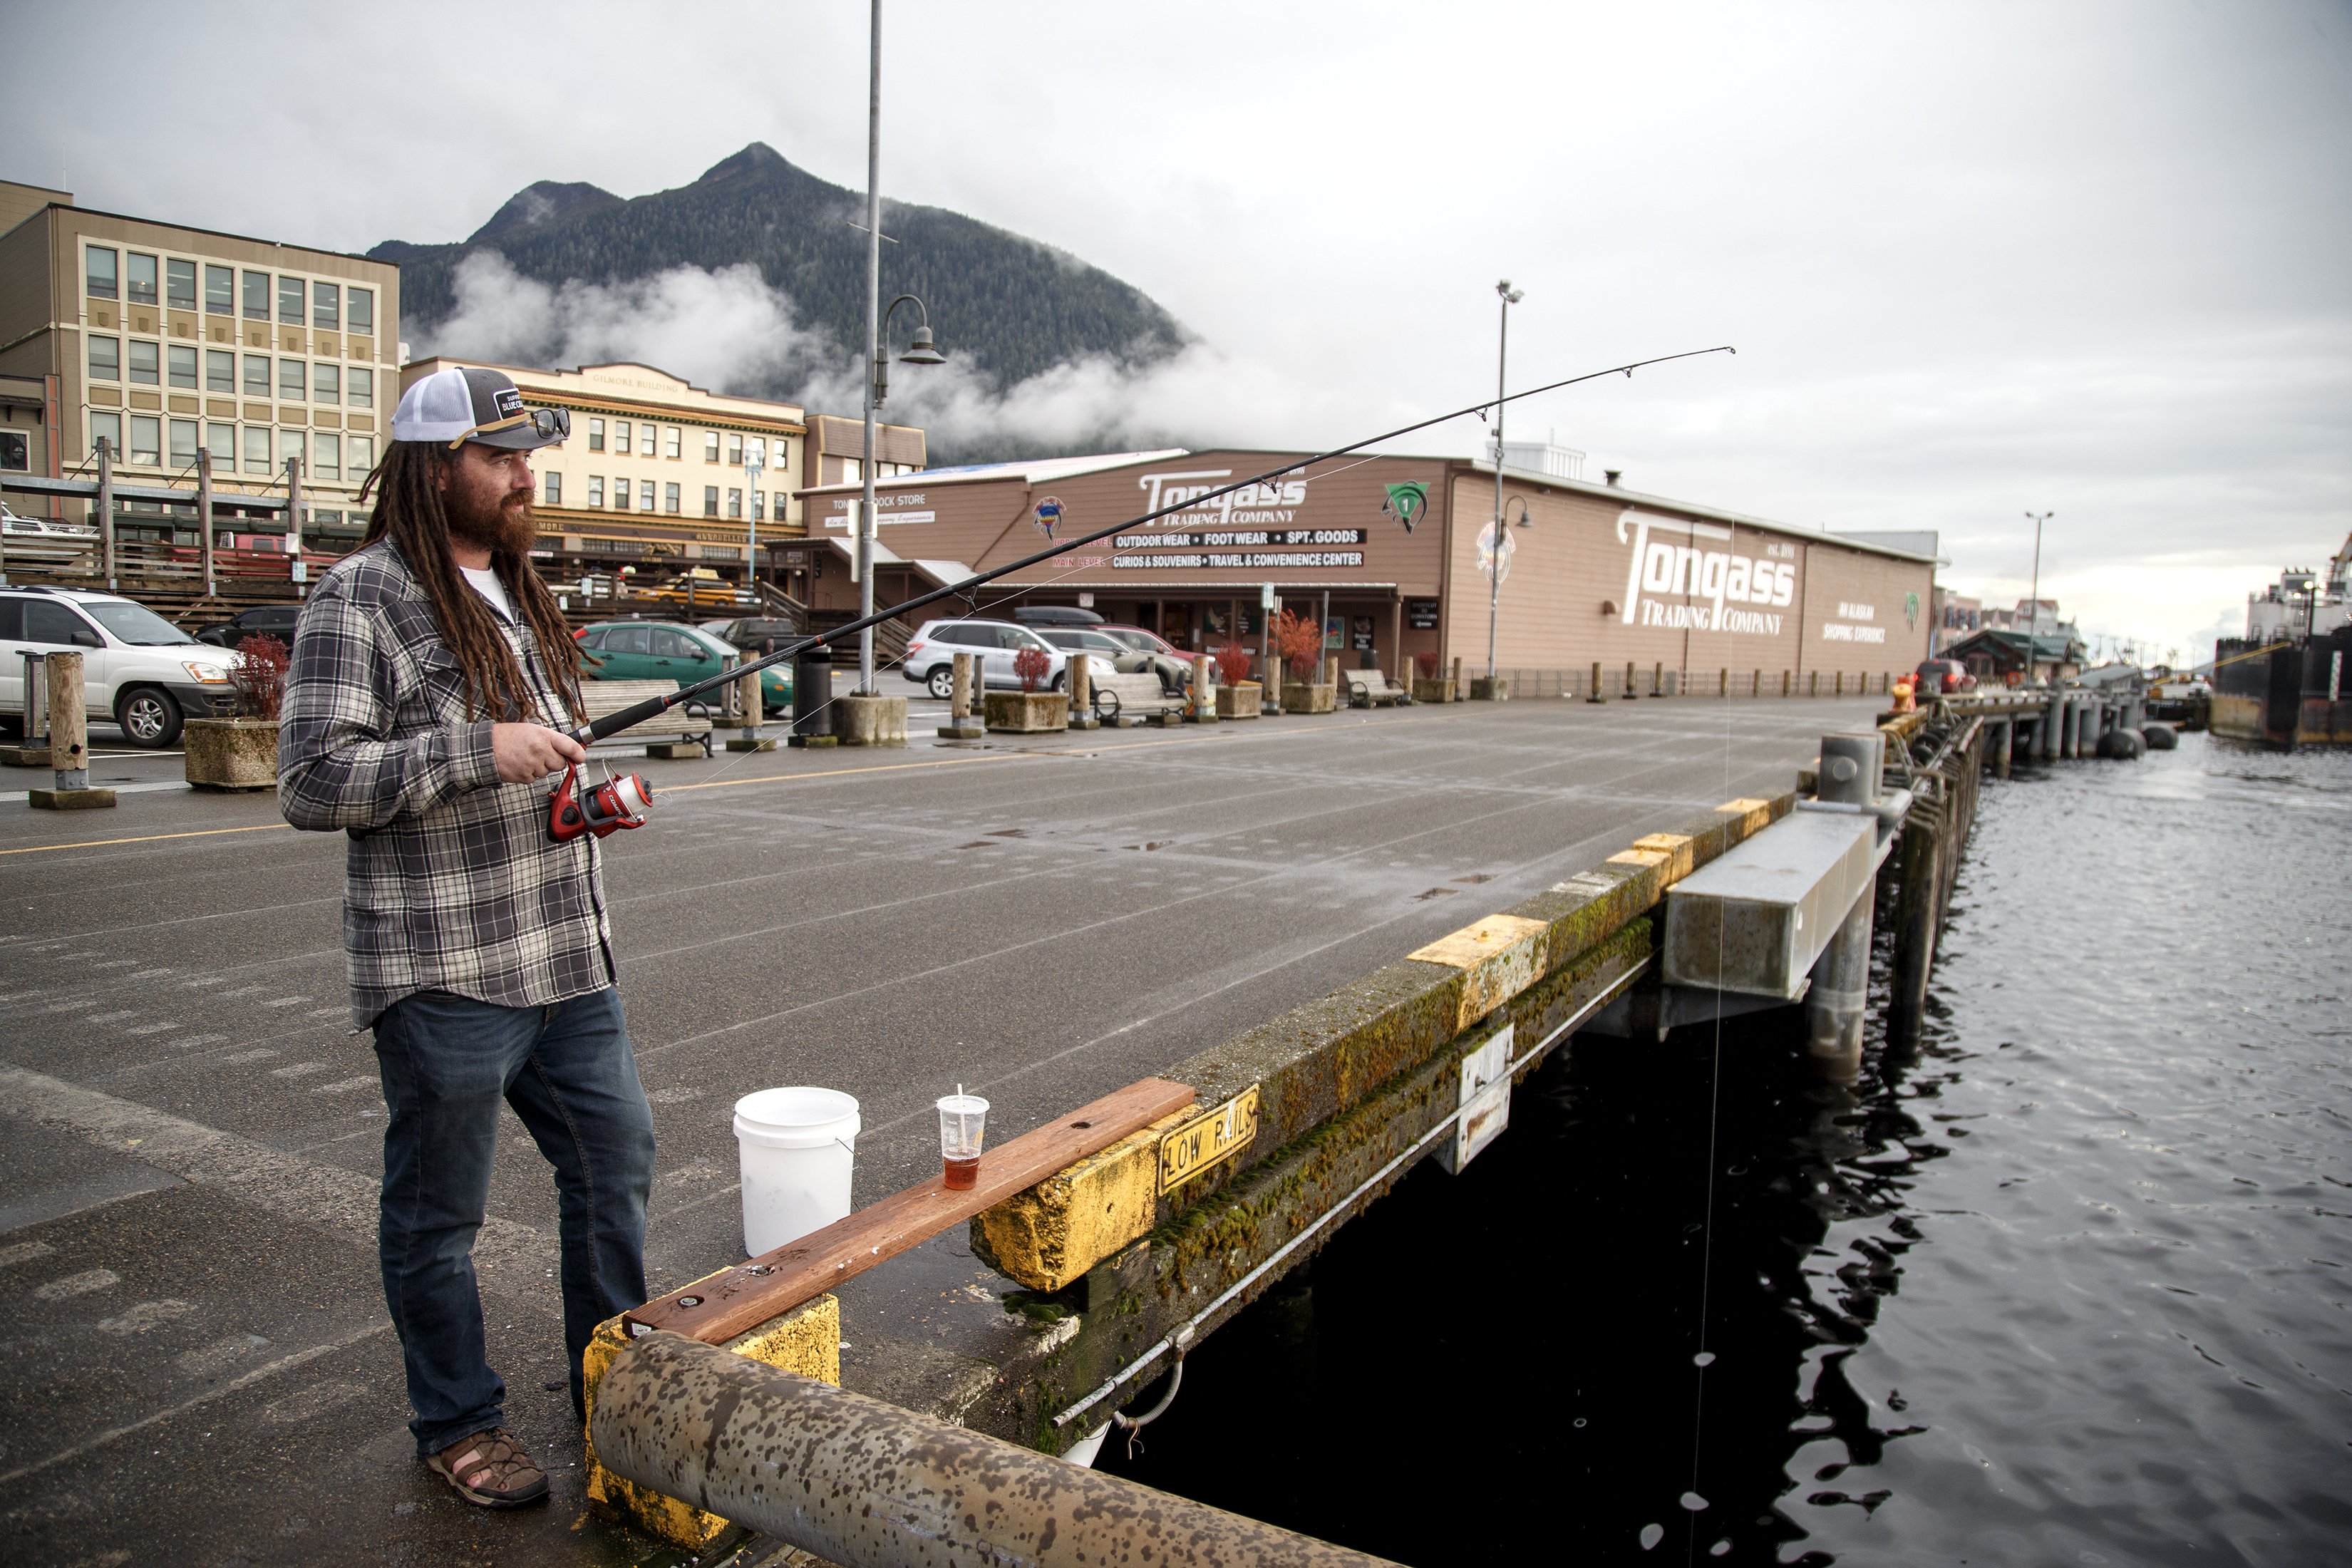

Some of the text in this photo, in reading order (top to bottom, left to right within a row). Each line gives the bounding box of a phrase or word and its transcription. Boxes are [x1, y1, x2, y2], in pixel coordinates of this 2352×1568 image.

[593, 374, 678, 392] GILMORE BUILDING
[502, 401, 517, 411] BLUE
[170, 481, 240, 493] KETCIKAN
[249, 487, 275, 496] CITY
[874, 497, 895, 507] DOCK
[898, 494, 925, 505] STORE
[1140, 469, 1307, 526] Tongass
[1403, 498, 1408, 511] 1
[898, 515, 932, 523] Experience
[1163, 510, 1296, 525] TRADING COMPANY
[538, 522, 564, 532] MORE
[696, 532, 746, 542] ANNABELLES
[1053, 538, 1080, 547] UPP
[1117, 534, 1190, 547] OUTDOOR WEAR
[1287, 530, 1358, 543] SPT. GOODS
[1053, 557, 1105, 567] MAIN LEVEL
[1113, 555, 1202, 567] CURIOS & SOUVENIRS
[1209, 552, 1362, 567] TRAVEL & CONVENIENCE CENTER
[1618, 510, 1795, 631] Tongass
[1642, 599, 1783, 634] TRADING COMPANY
[1839, 602, 1874, 620] AN ALASKAN
[1824, 624, 1885, 643] SHOPPING EXPERIENCE
[1167, 1130, 1202, 1177] LOW
